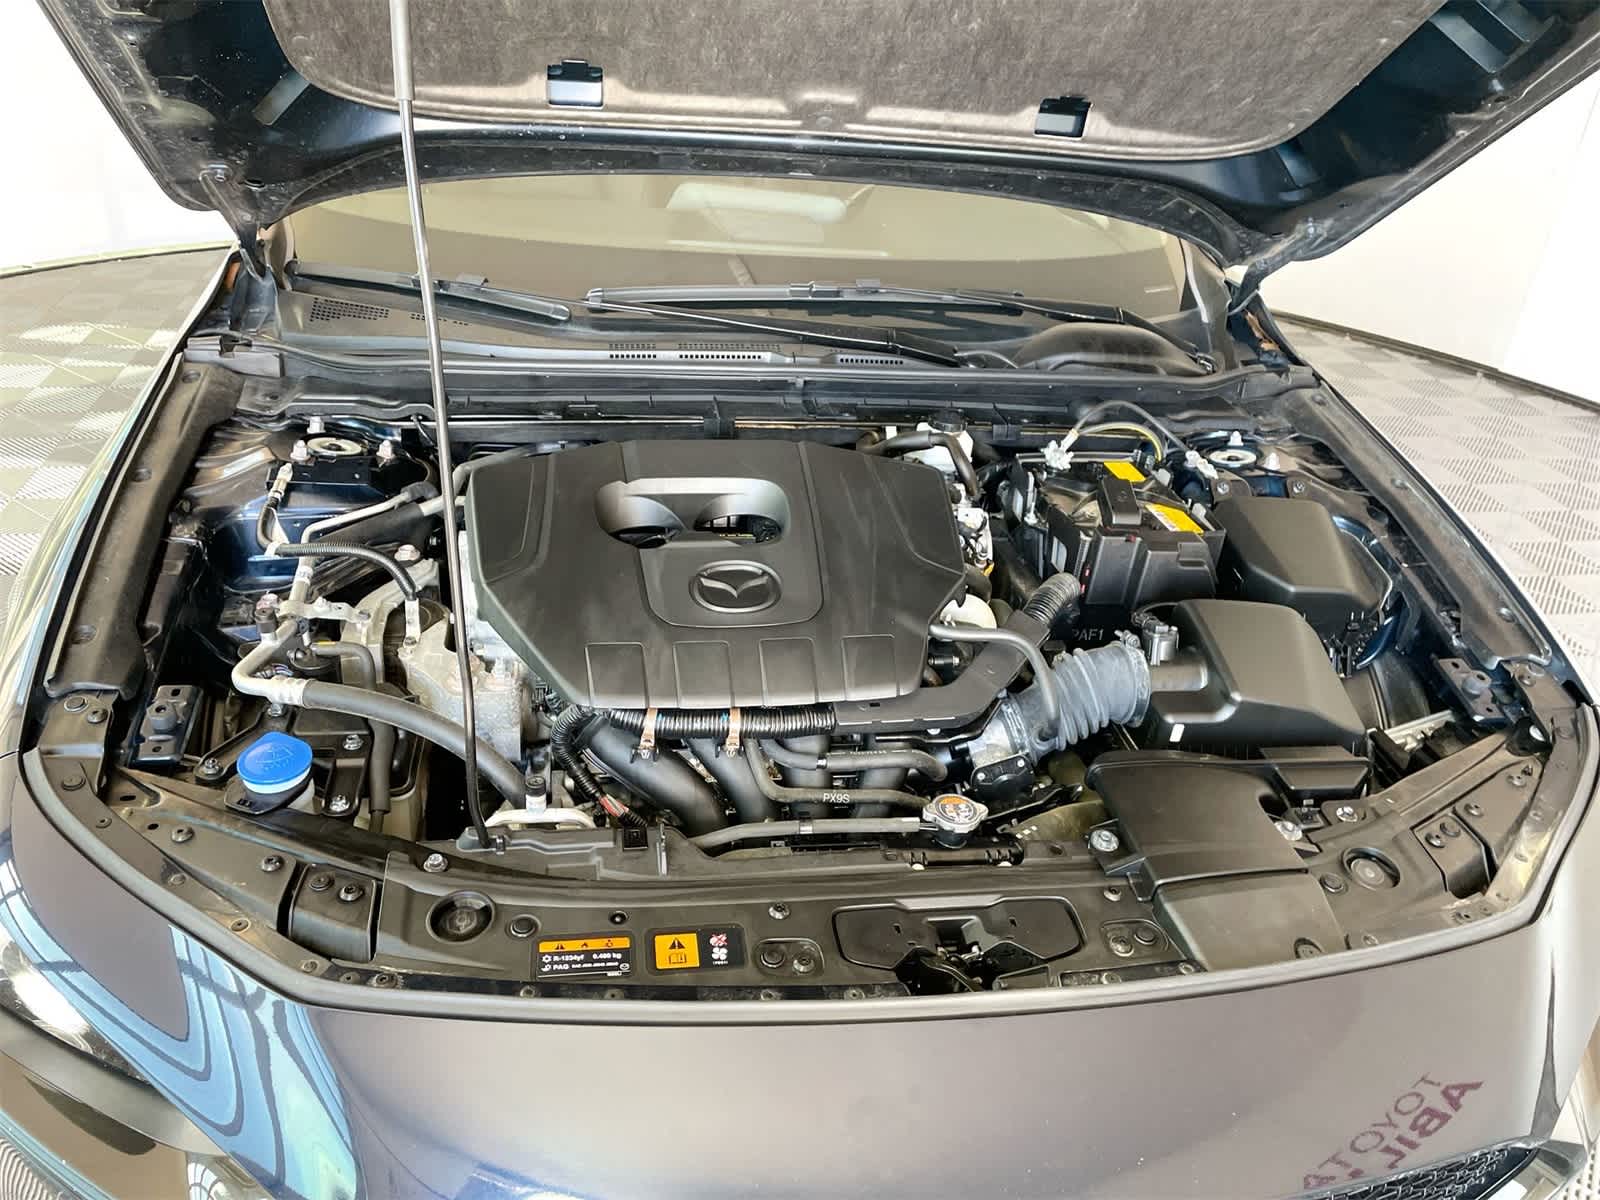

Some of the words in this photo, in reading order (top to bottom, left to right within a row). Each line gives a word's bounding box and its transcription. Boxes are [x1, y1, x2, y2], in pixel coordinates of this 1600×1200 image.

[822, 792, 850, 804] PX9S
[612, 951, 622, 960] kg
[552, 963, 570, 971] PAG
